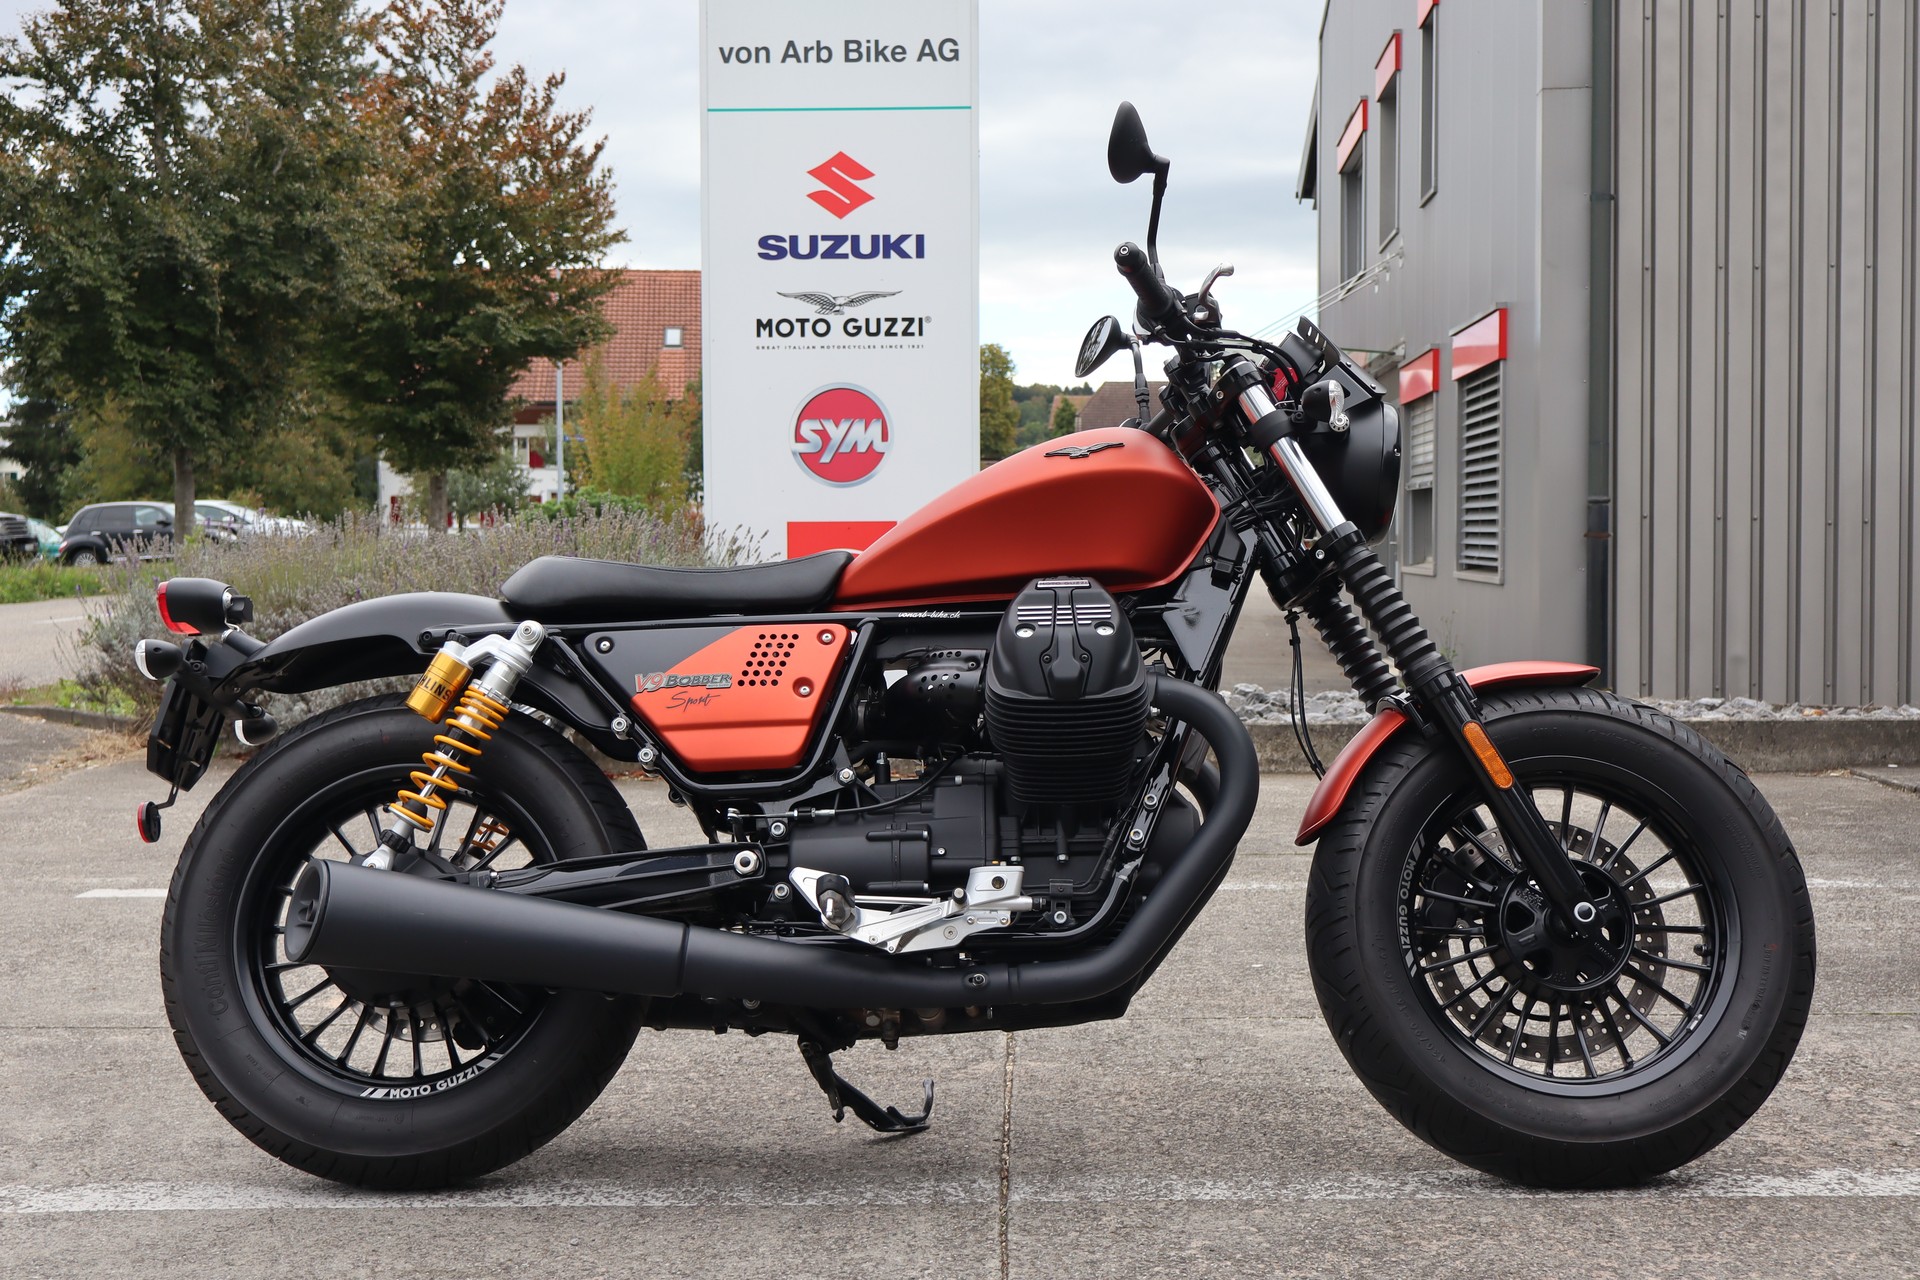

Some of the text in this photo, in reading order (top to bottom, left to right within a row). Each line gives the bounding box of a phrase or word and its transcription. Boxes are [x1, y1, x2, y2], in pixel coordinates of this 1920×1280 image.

[718, 38, 960, 64] von Arb Bike AG
[757, 234, 925, 261] SUZUKI
[756, 318, 831, 338] MOTO
[793, 418, 887, 464] SYM
[419, 674, 452, 700] HLINS
[635, 672, 732, 693] V9 BOBBER
[666, 690, 721, 712] Sport
[1398, 858, 1417, 949] MOTO GUZZI
[390, 1065, 480, 1099] MOTO GUZZI
